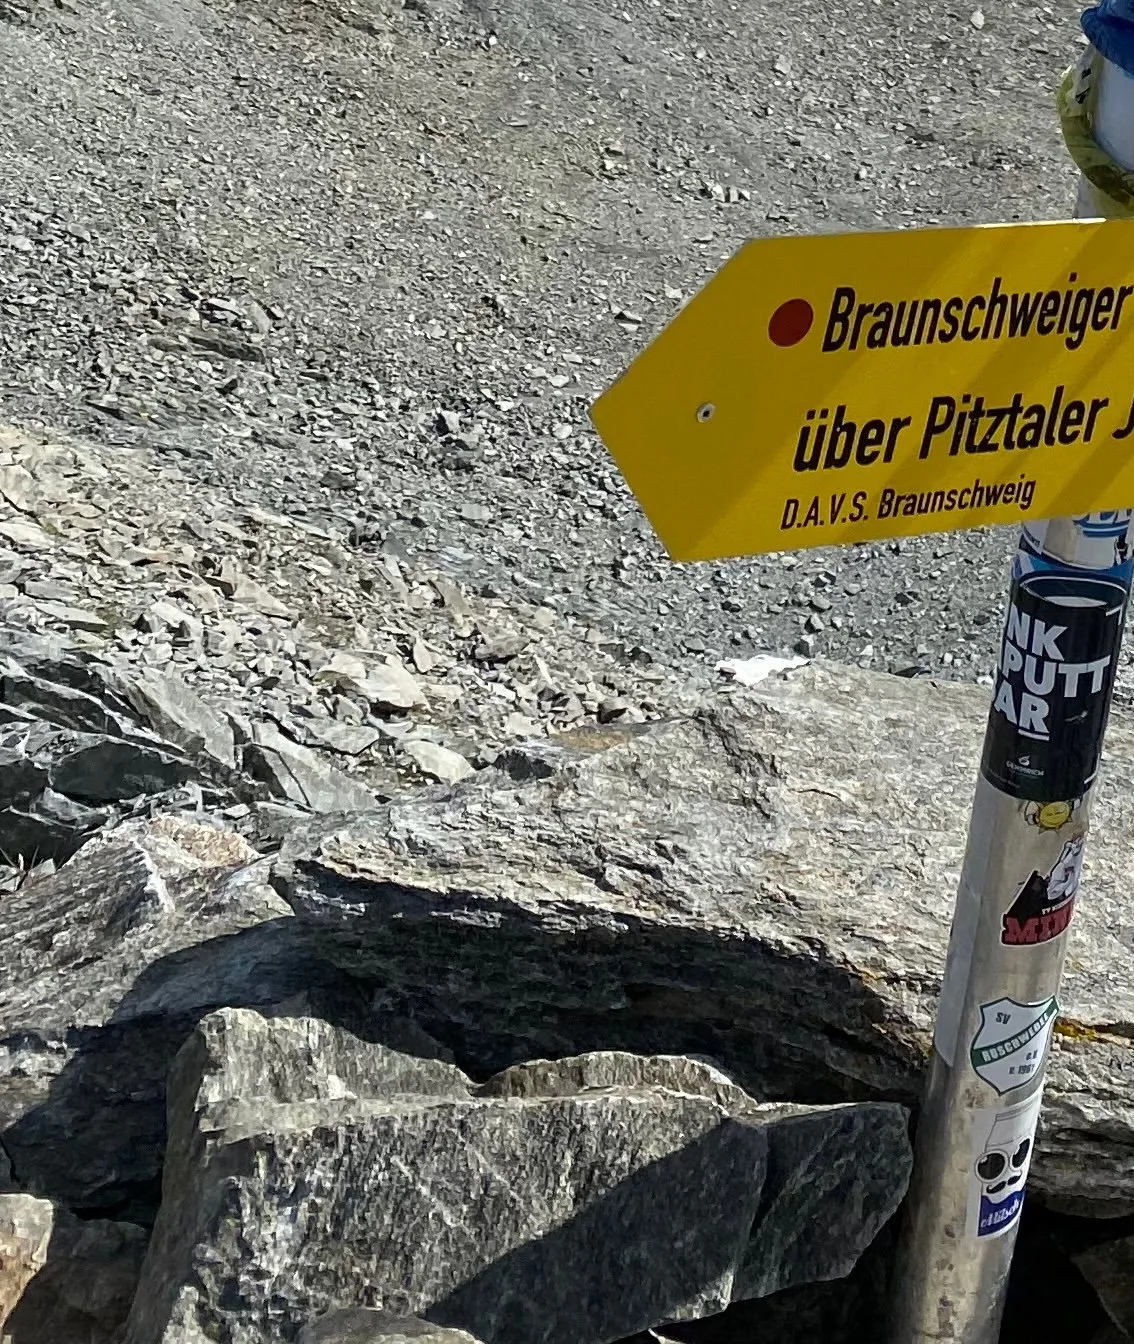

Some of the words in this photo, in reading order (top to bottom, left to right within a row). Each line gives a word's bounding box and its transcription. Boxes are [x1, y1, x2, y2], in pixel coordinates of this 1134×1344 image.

[822, 272, 1134, 353] Braunschweiger
[792, 404, 913, 472] über
[919, 385, 1109, 460] Pitztaler
[780, 490, 869, 531] D.A.V.S.
[878, 473, 1037, 520] Braunschweig
